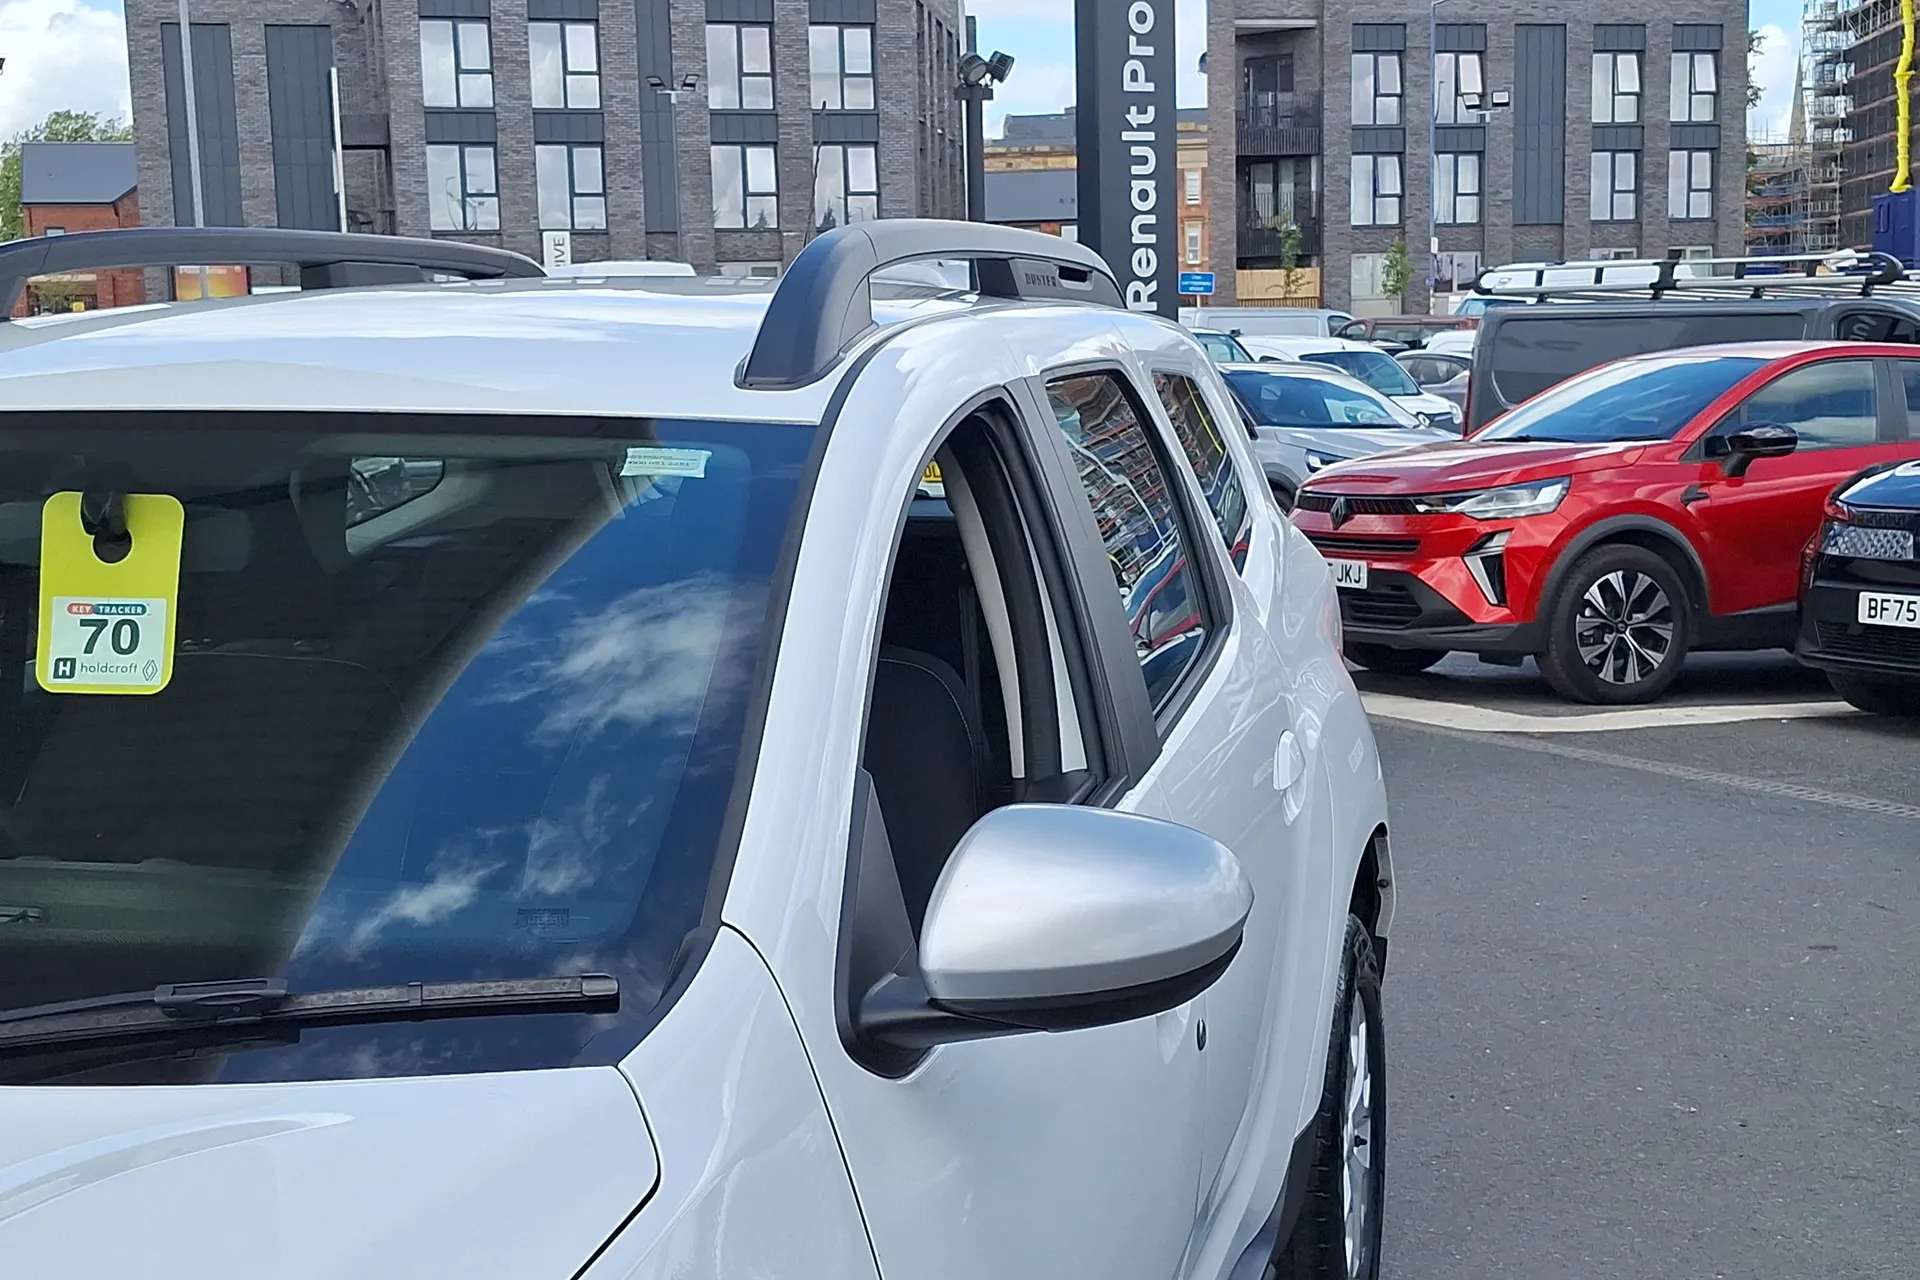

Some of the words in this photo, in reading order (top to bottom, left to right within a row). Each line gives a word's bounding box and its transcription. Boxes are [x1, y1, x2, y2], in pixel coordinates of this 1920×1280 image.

[1123, 0, 1155, 92] Pro
[1121, 105, 1158, 312] Renault
[553, 237, 565, 267] IVE
[1336, 563, 1361, 584] JKJ
[71, 605, 92, 613] KEY
[99, 605, 143, 614] TRACKER
[1867, 597, 1918, 622] BF75
[80, 618, 139, 655] 70
[80, 662, 137, 673] holdcroft
